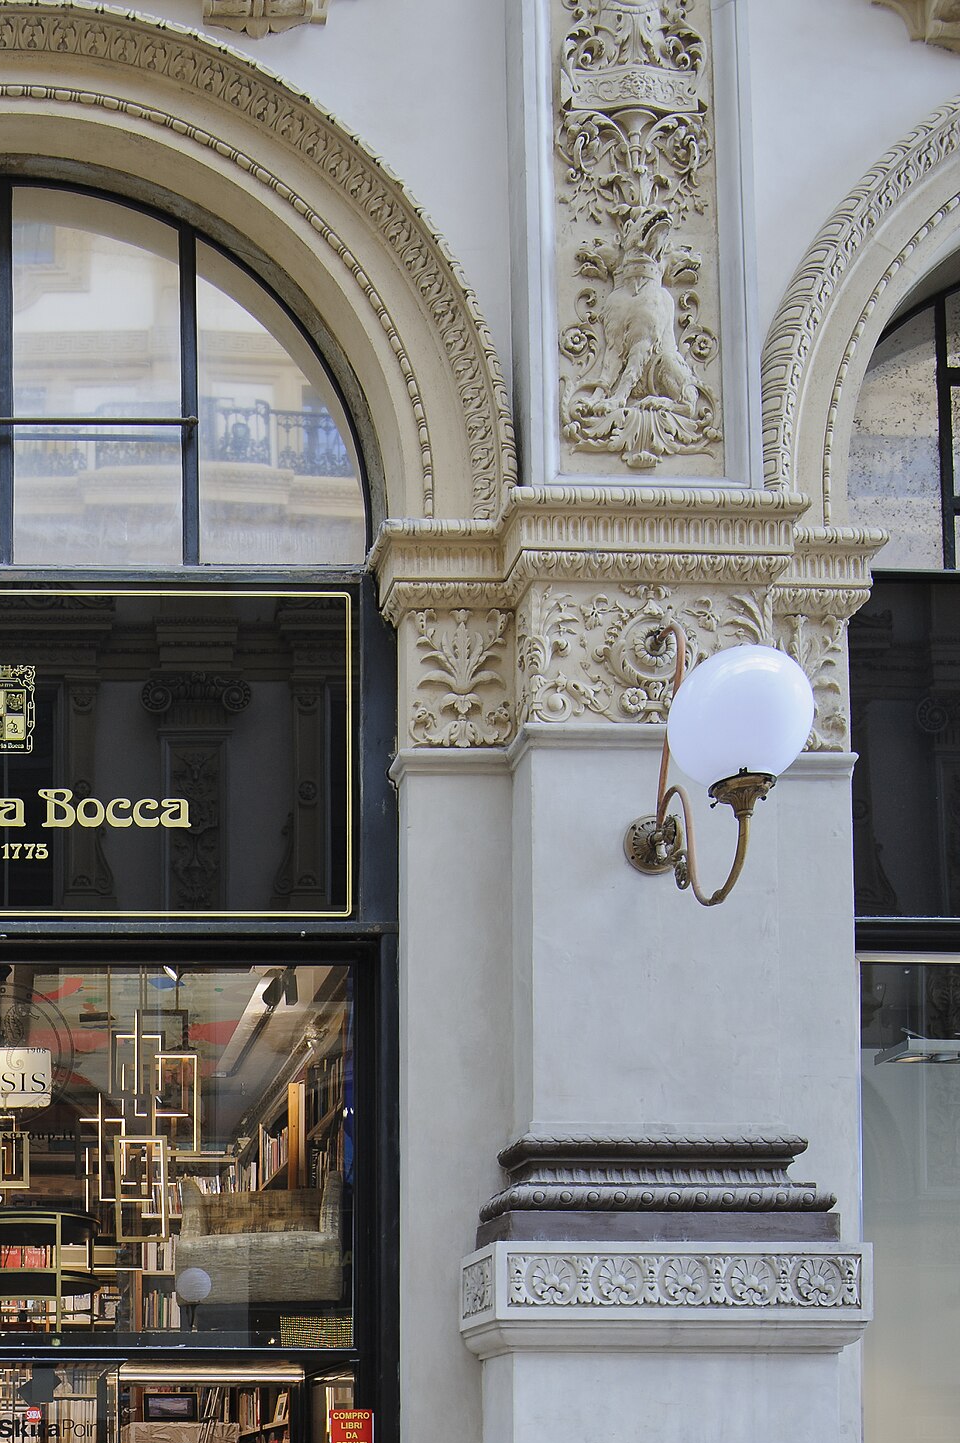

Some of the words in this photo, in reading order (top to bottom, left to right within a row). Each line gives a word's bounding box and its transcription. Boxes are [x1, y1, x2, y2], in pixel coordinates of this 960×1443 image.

[38, 788, 191, 828] Bocca
[1, 843, 49, 860] 1775
[26, 1409, 42, 1420] SKIRA
[333, 1412, 370, 1420] COMPRO
[340, 1422, 363, 1430] LIBRI
